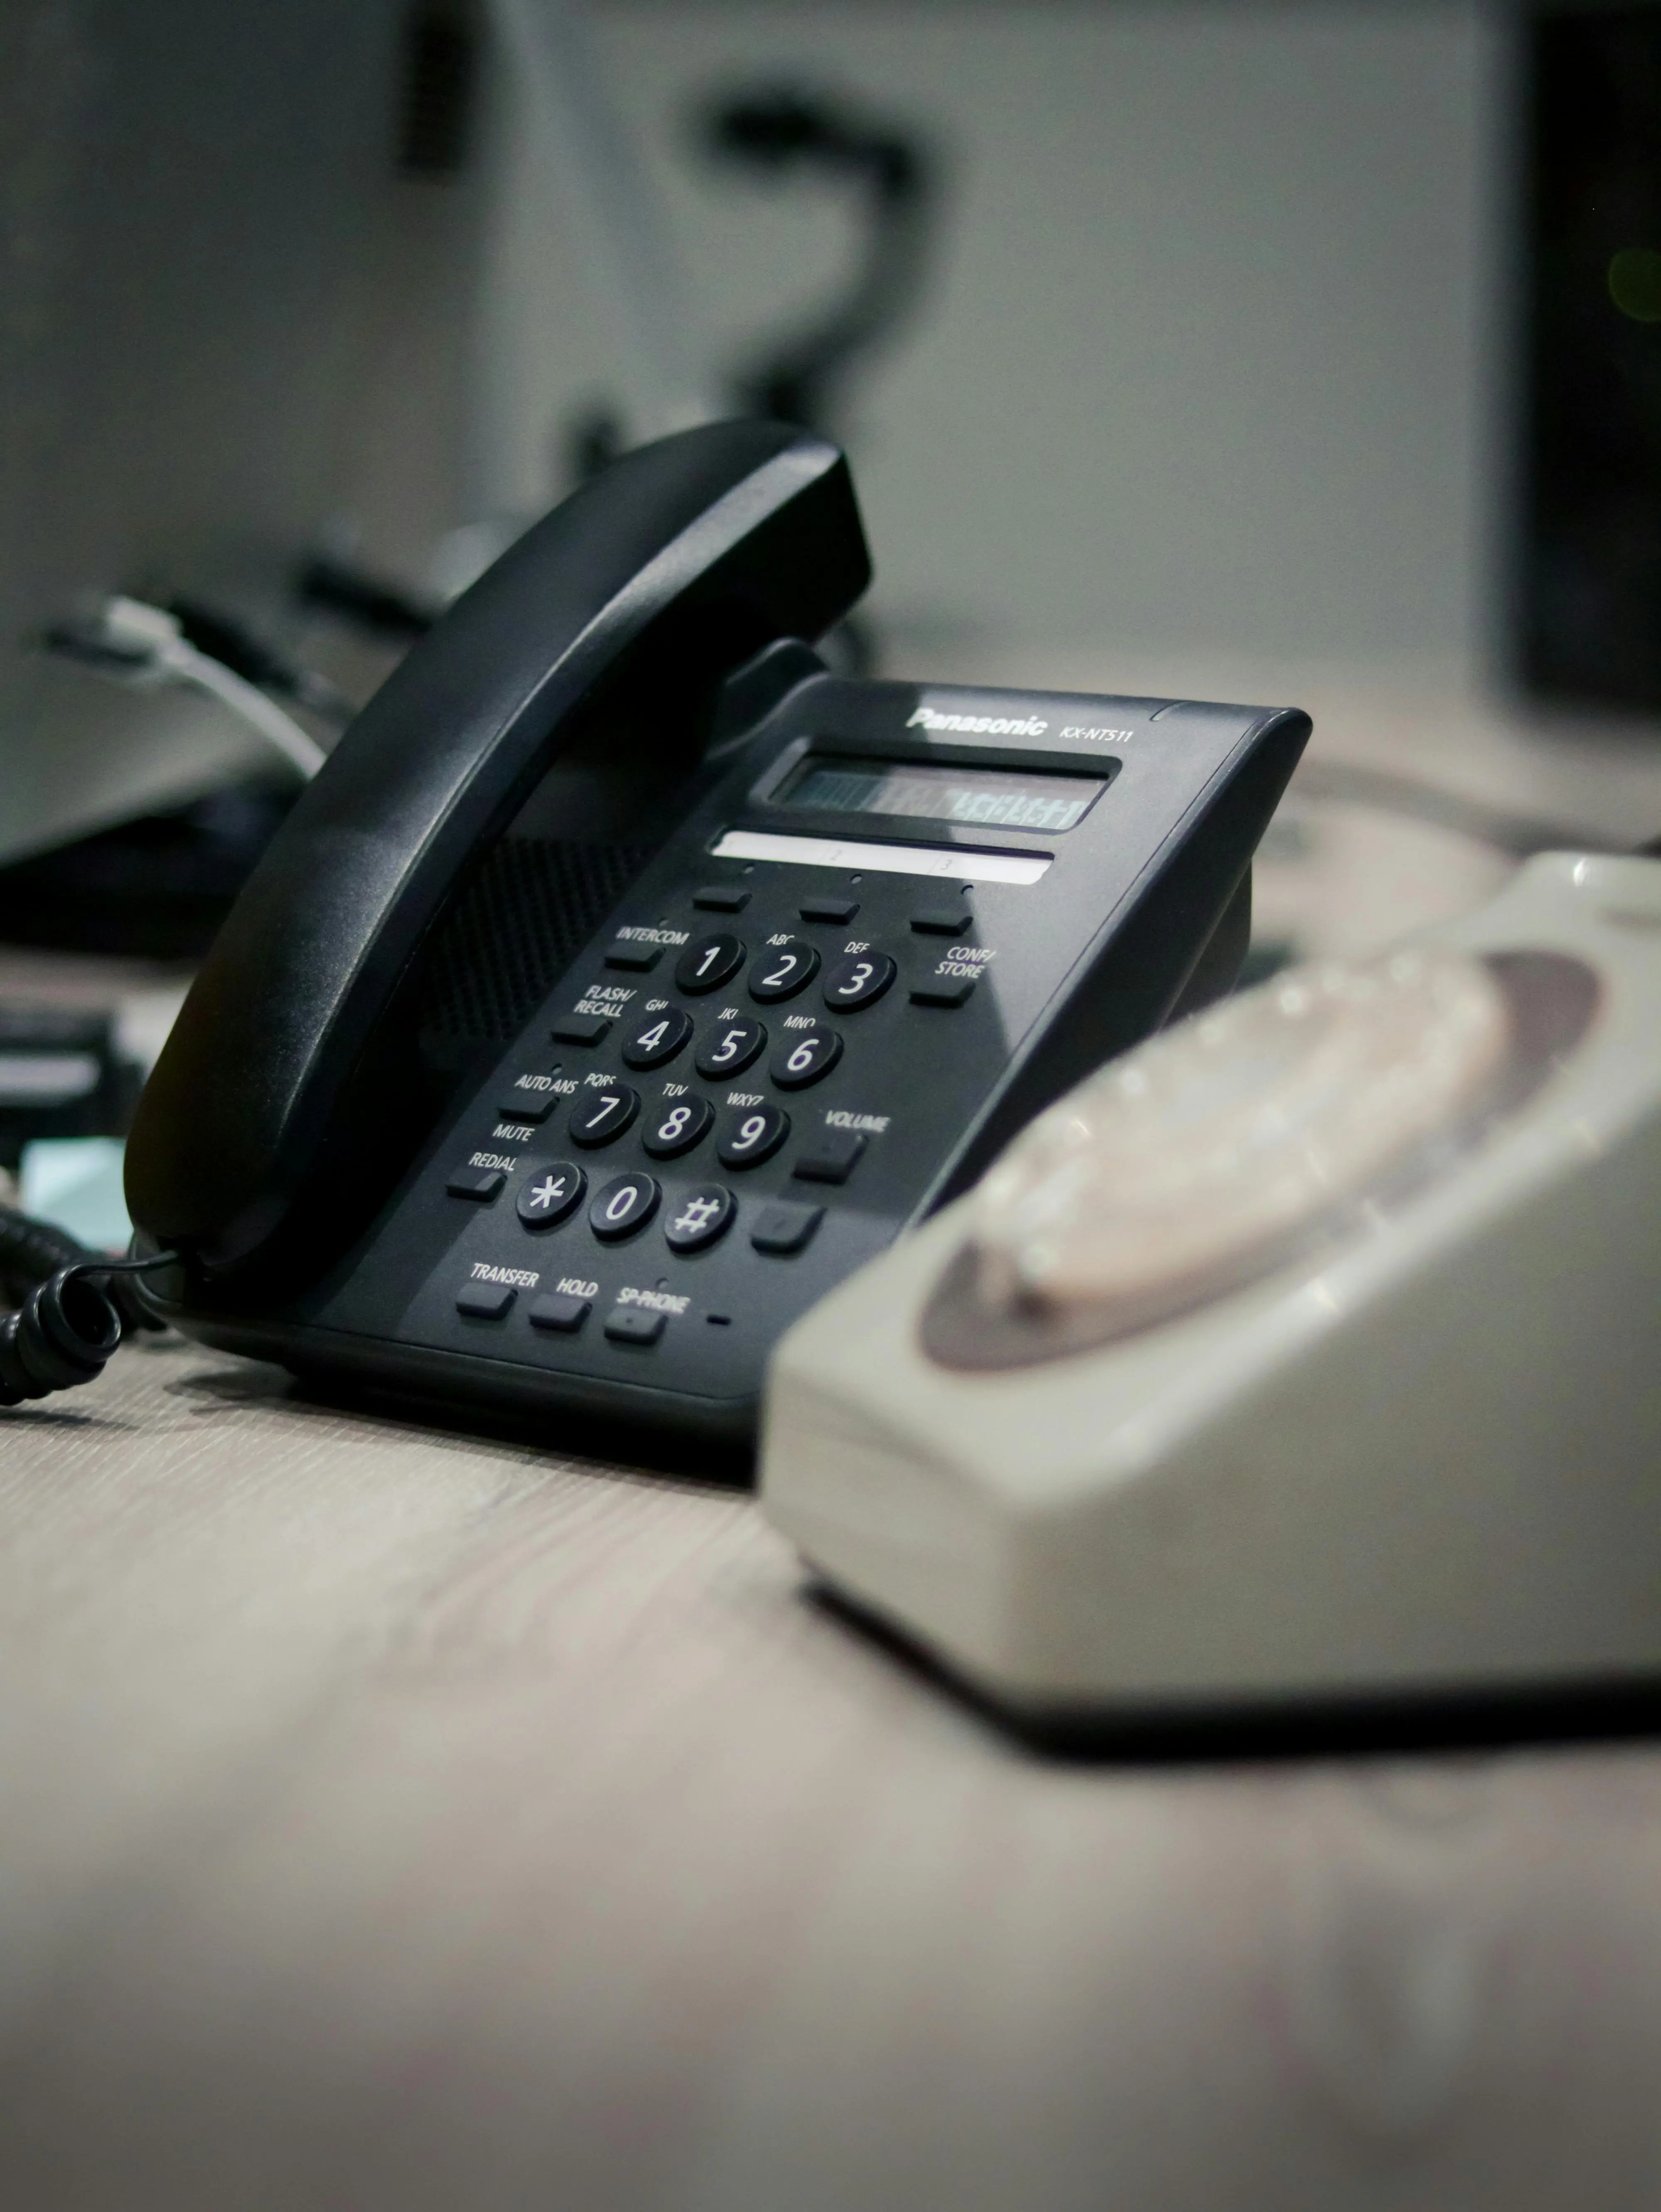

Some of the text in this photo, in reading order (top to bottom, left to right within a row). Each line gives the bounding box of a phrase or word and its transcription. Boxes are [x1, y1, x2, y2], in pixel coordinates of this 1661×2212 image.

[906, 707, 1048, 736] Panasonic
[1060, 727, 1133, 742] KX-NT511
[617, 927, 689, 945] INTERCOM
[844, 942, 870, 953] DEF
[948, 947, 996, 962] CONF/
[696, 947, 720, 976] 1
[762, 955, 796, 985] 2
[935, 961, 985, 978] STORE
[838, 964, 873, 994] 3
[586, 986, 637, 1001] FLASH/
[574, 999, 624, 1017] RECALL
[646, 1000, 668, 1011] GHI
[637, 1021, 669, 1051] 4
[712, 1030, 747, 1061] 5
[788, 1039, 819, 1071] 6
[515, 1074, 578, 1094] AUTO ANS
[663, 1084, 688, 1096] TUV
[586, 1097, 620, 1128] 7
[659, 1107, 691, 1139] 8
[826, 1111, 889, 1132] VOLUME
[493, 1124, 534, 1141] MUTE
[732, 1116, 765, 1149] 9
[469, 1152, 516, 1172] REDIAL
[606, 1187, 637, 1220] 0
[471, 1263, 539, 1287] TRANSFER
[557, 1278, 598, 1297] HOLD
[617, 1288, 690, 1313] SP-PHONE
